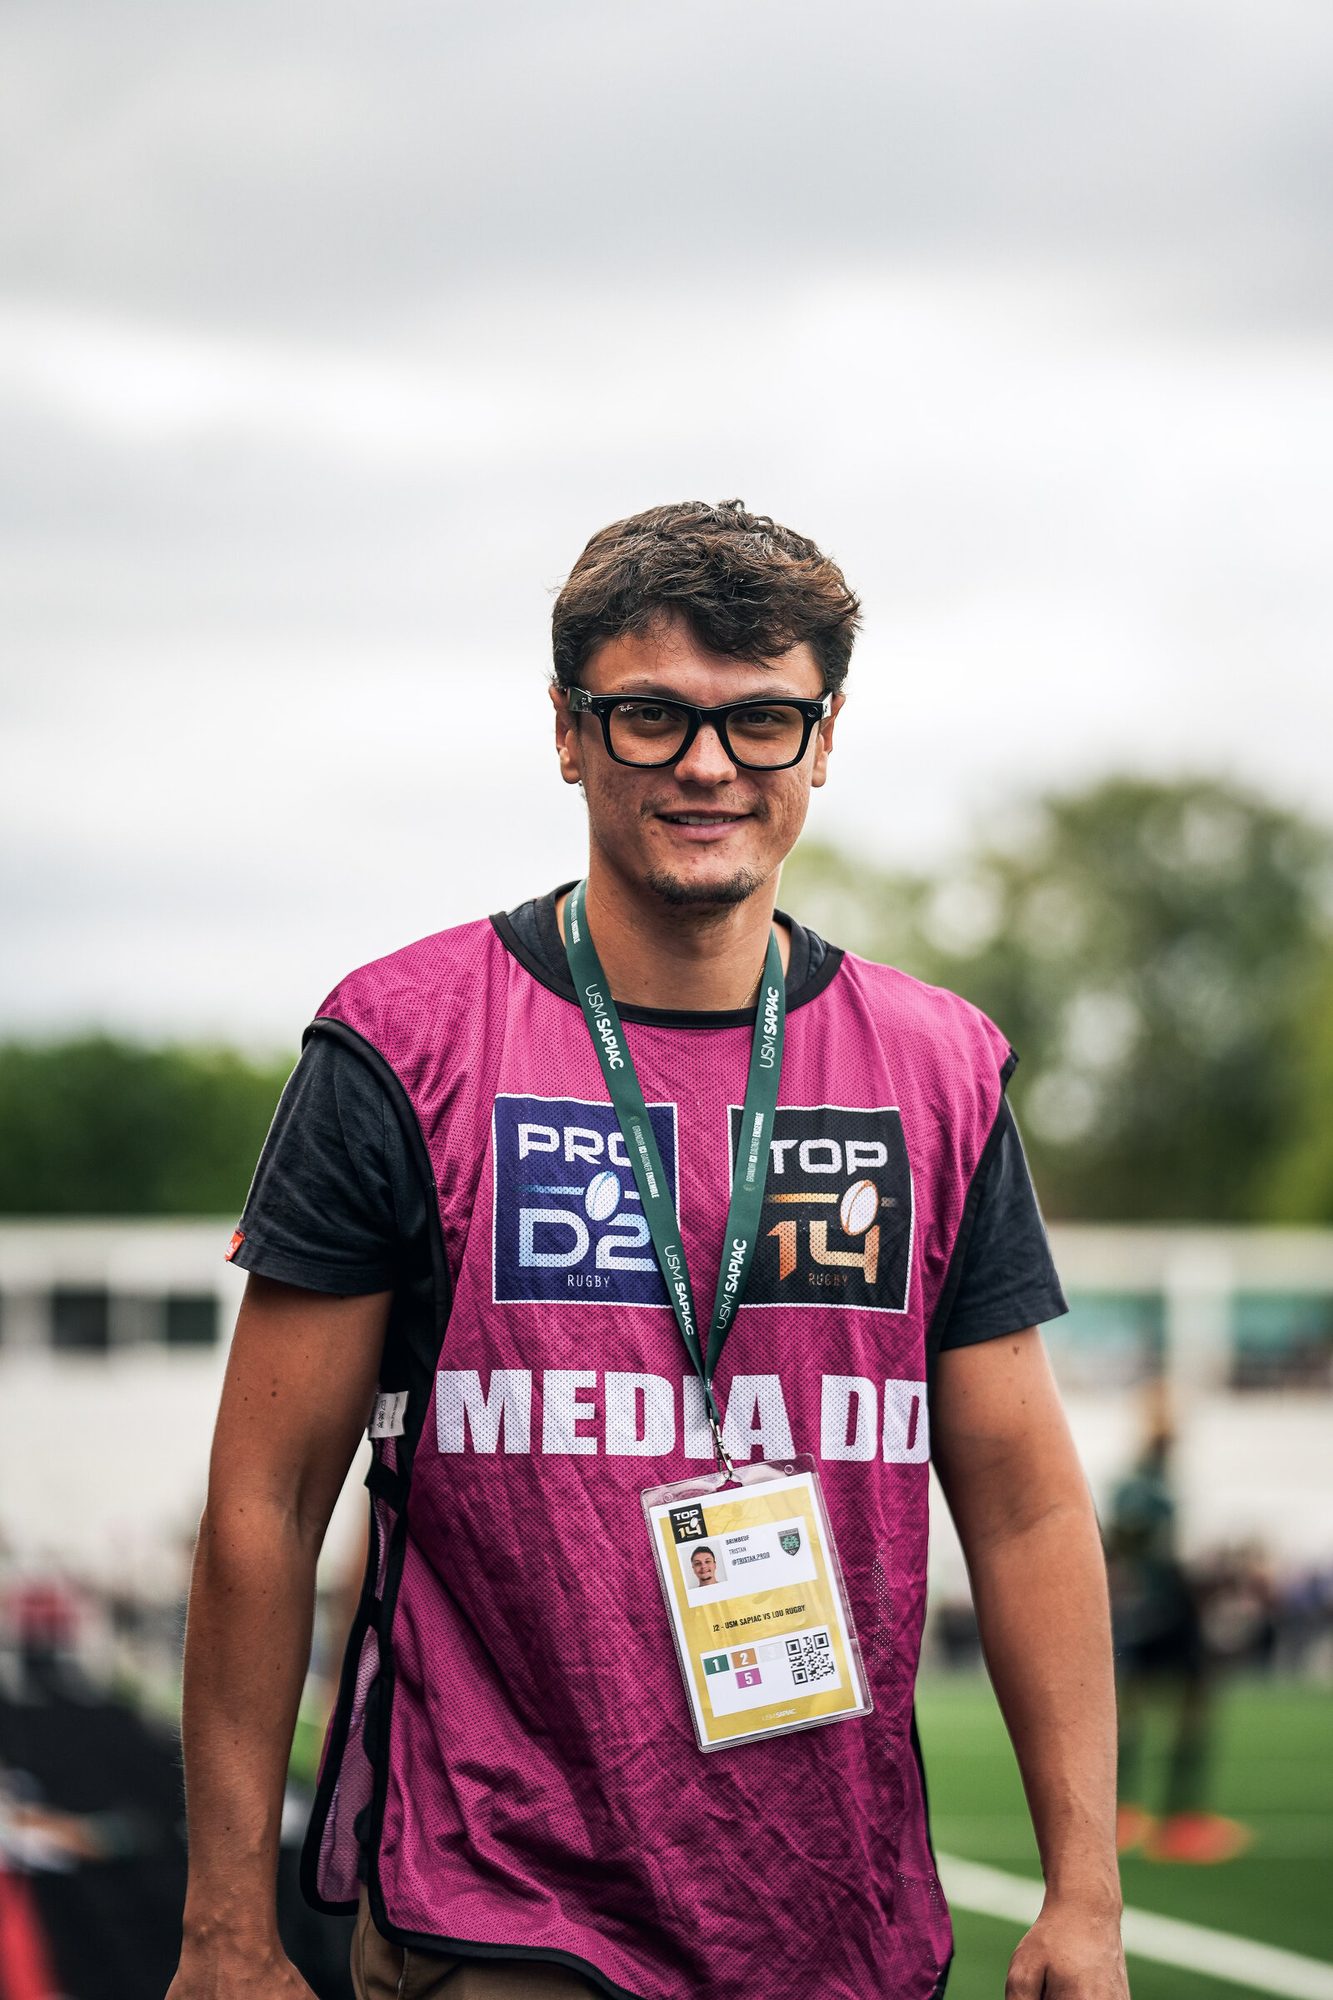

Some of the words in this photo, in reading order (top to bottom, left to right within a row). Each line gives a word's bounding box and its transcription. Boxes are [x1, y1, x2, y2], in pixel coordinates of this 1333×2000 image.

[585, 983, 608, 1018] USM
[763, 986, 780, 1036] SAPIAC
[596, 1018, 625, 1070] SAPIAC
[759, 1035, 776, 1069] USM
[752, 1111, 764, 1138] ENSEMBLE
[770, 1138, 888, 1175] TOP
[645, 1171, 660, 1198] ENSEMBLE
[518, 1208, 658, 1272] D2
[767, 1220, 881, 1284] 14
[567, 1274, 610, 1288] RUGBY
[724, 1238, 748, 1294] SAPIAC
[808, 1272, 849, 1287] RUGBY
[664, 1245, 684, 1280] USM
[674, 1282, 694, 1336] SAPIAC
[716, 1294, 735, 1330] USM
[435, 1369, 797, 1461] MEDIA
[673, 1509, 699, 1521] TOP
[678, 1523, 702, 1539] 14
[725, 1619, 738, 1629] USM
[740, 1614, 762, 1626] SAPIAC
[762, 1612, 771, 1620] VS
[772, 1609, 784, 1618] LOU
[785, 1604, 806, 1615] RUGBY
[712, 1658, 720, 1671] 1
[740, 1652, 749, 1665] 2
[744, 1672, 753, 1685] 5
